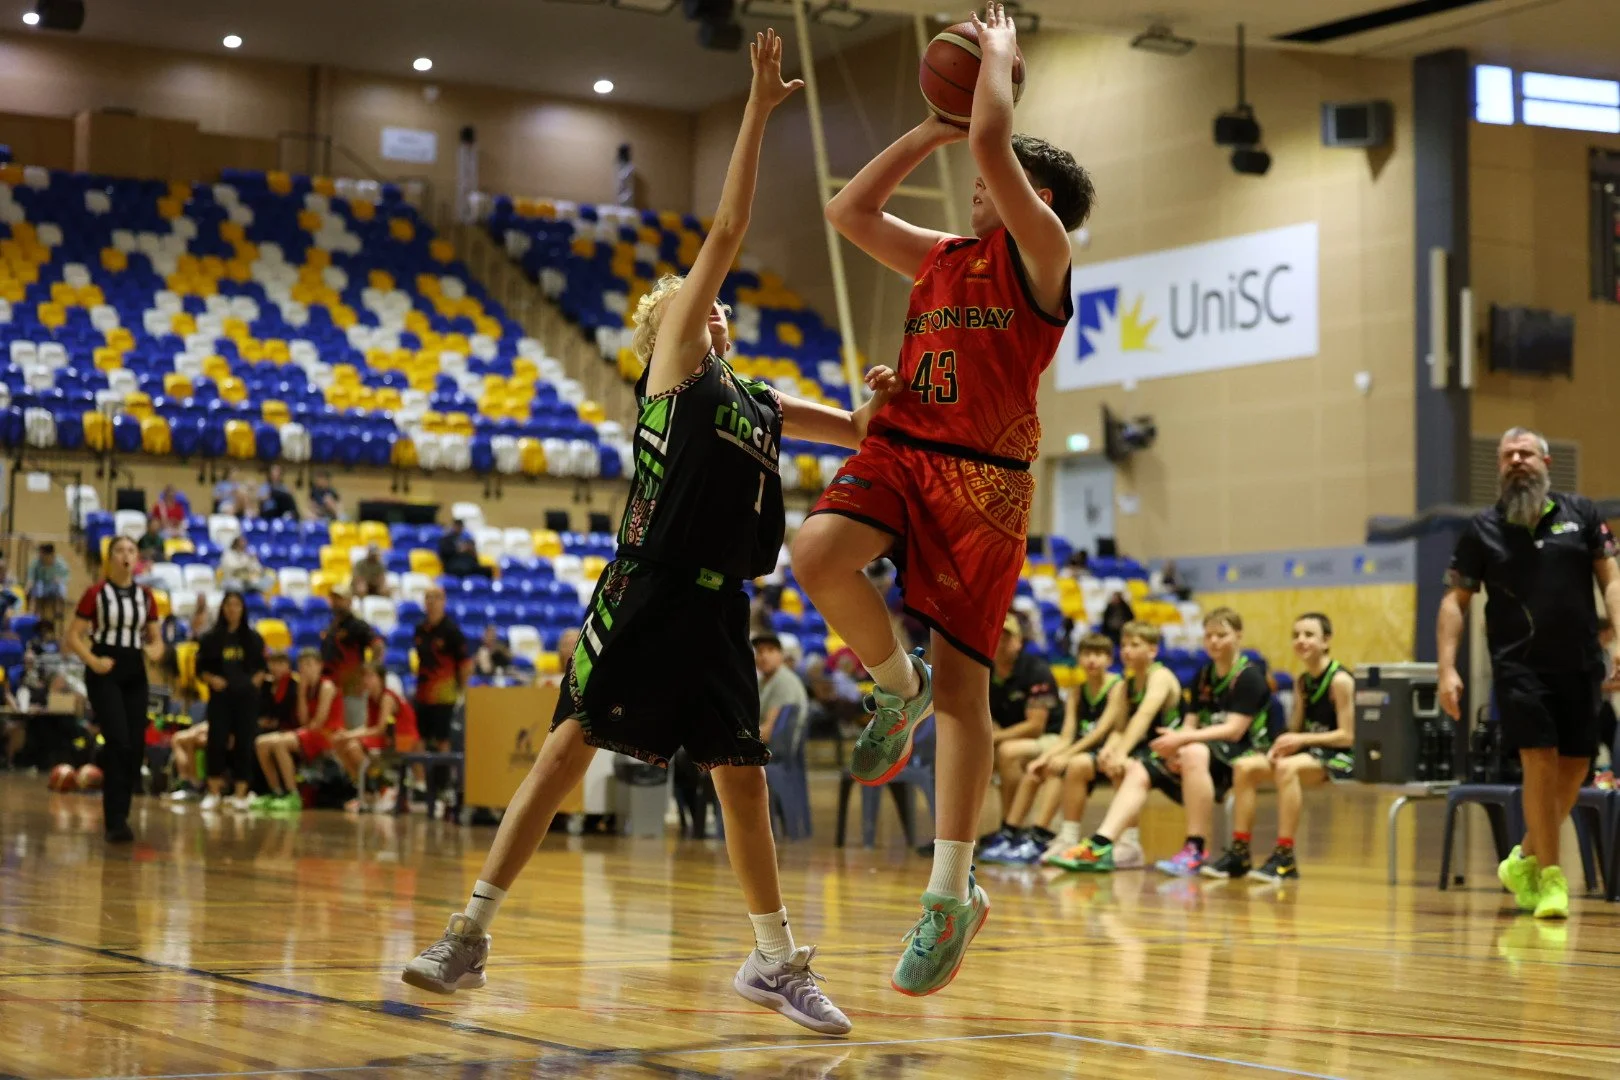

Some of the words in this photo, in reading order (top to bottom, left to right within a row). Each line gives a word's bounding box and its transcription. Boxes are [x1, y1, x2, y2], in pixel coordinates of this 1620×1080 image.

[904, 306, 961, 335] RETON
[965, 306, 1014, 330] BAY
[1170, 264, 1291, 339] UniSC
[910, 350, 958, 404] 43
